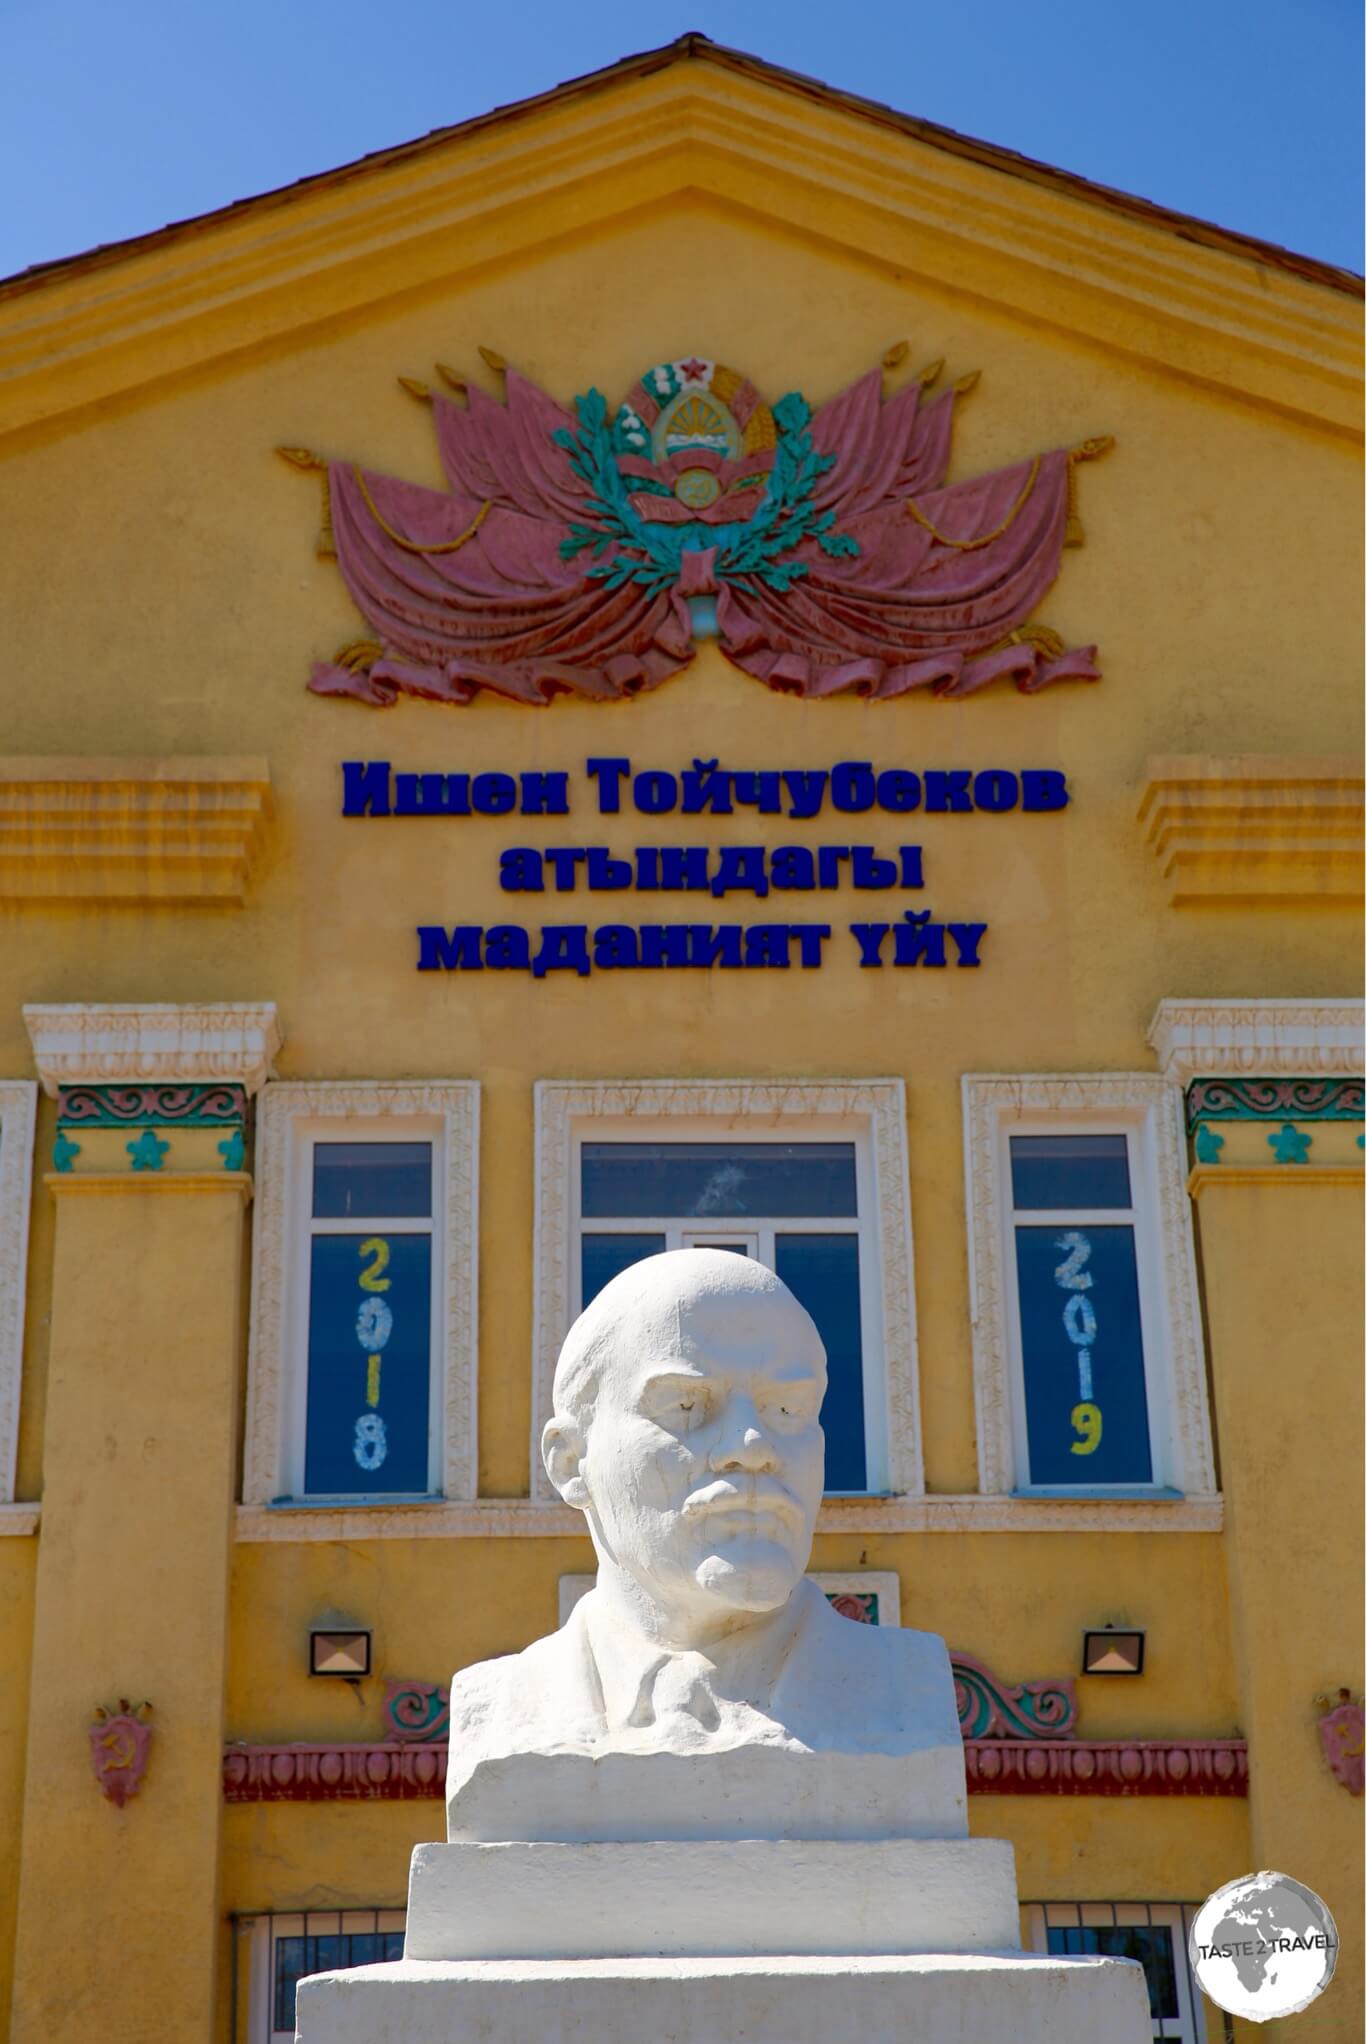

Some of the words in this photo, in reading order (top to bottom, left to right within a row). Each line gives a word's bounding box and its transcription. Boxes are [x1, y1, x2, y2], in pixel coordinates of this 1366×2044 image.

[342, 762, 569, 816] Ишен
[587, 758, 1070, 818] Тойчубеков
[499, 846, 924, 897] атындагы
[417, 925, 831, 978] маданият
